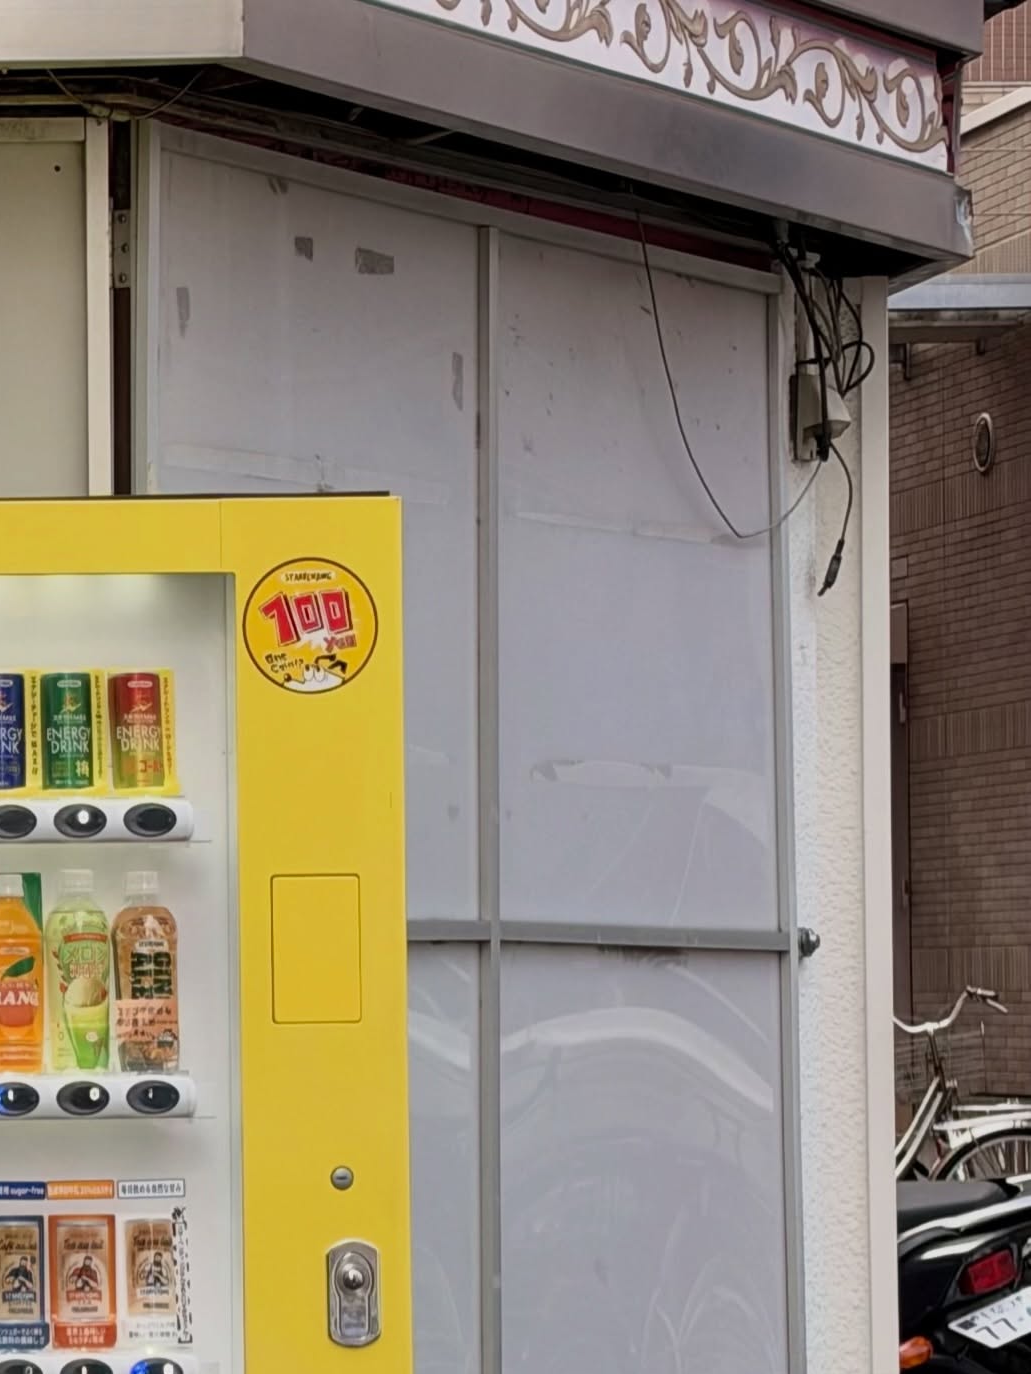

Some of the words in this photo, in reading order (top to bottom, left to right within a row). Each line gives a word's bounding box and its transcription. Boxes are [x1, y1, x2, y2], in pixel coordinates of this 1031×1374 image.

[259, 590, 353, 647] 100
[46, 726, 90, 741] ENERGY
[116, 726, 160, 740] ENERGY
[50, 740, 89, 754] DRINK
[120, 738, 160, 752] DRINK
